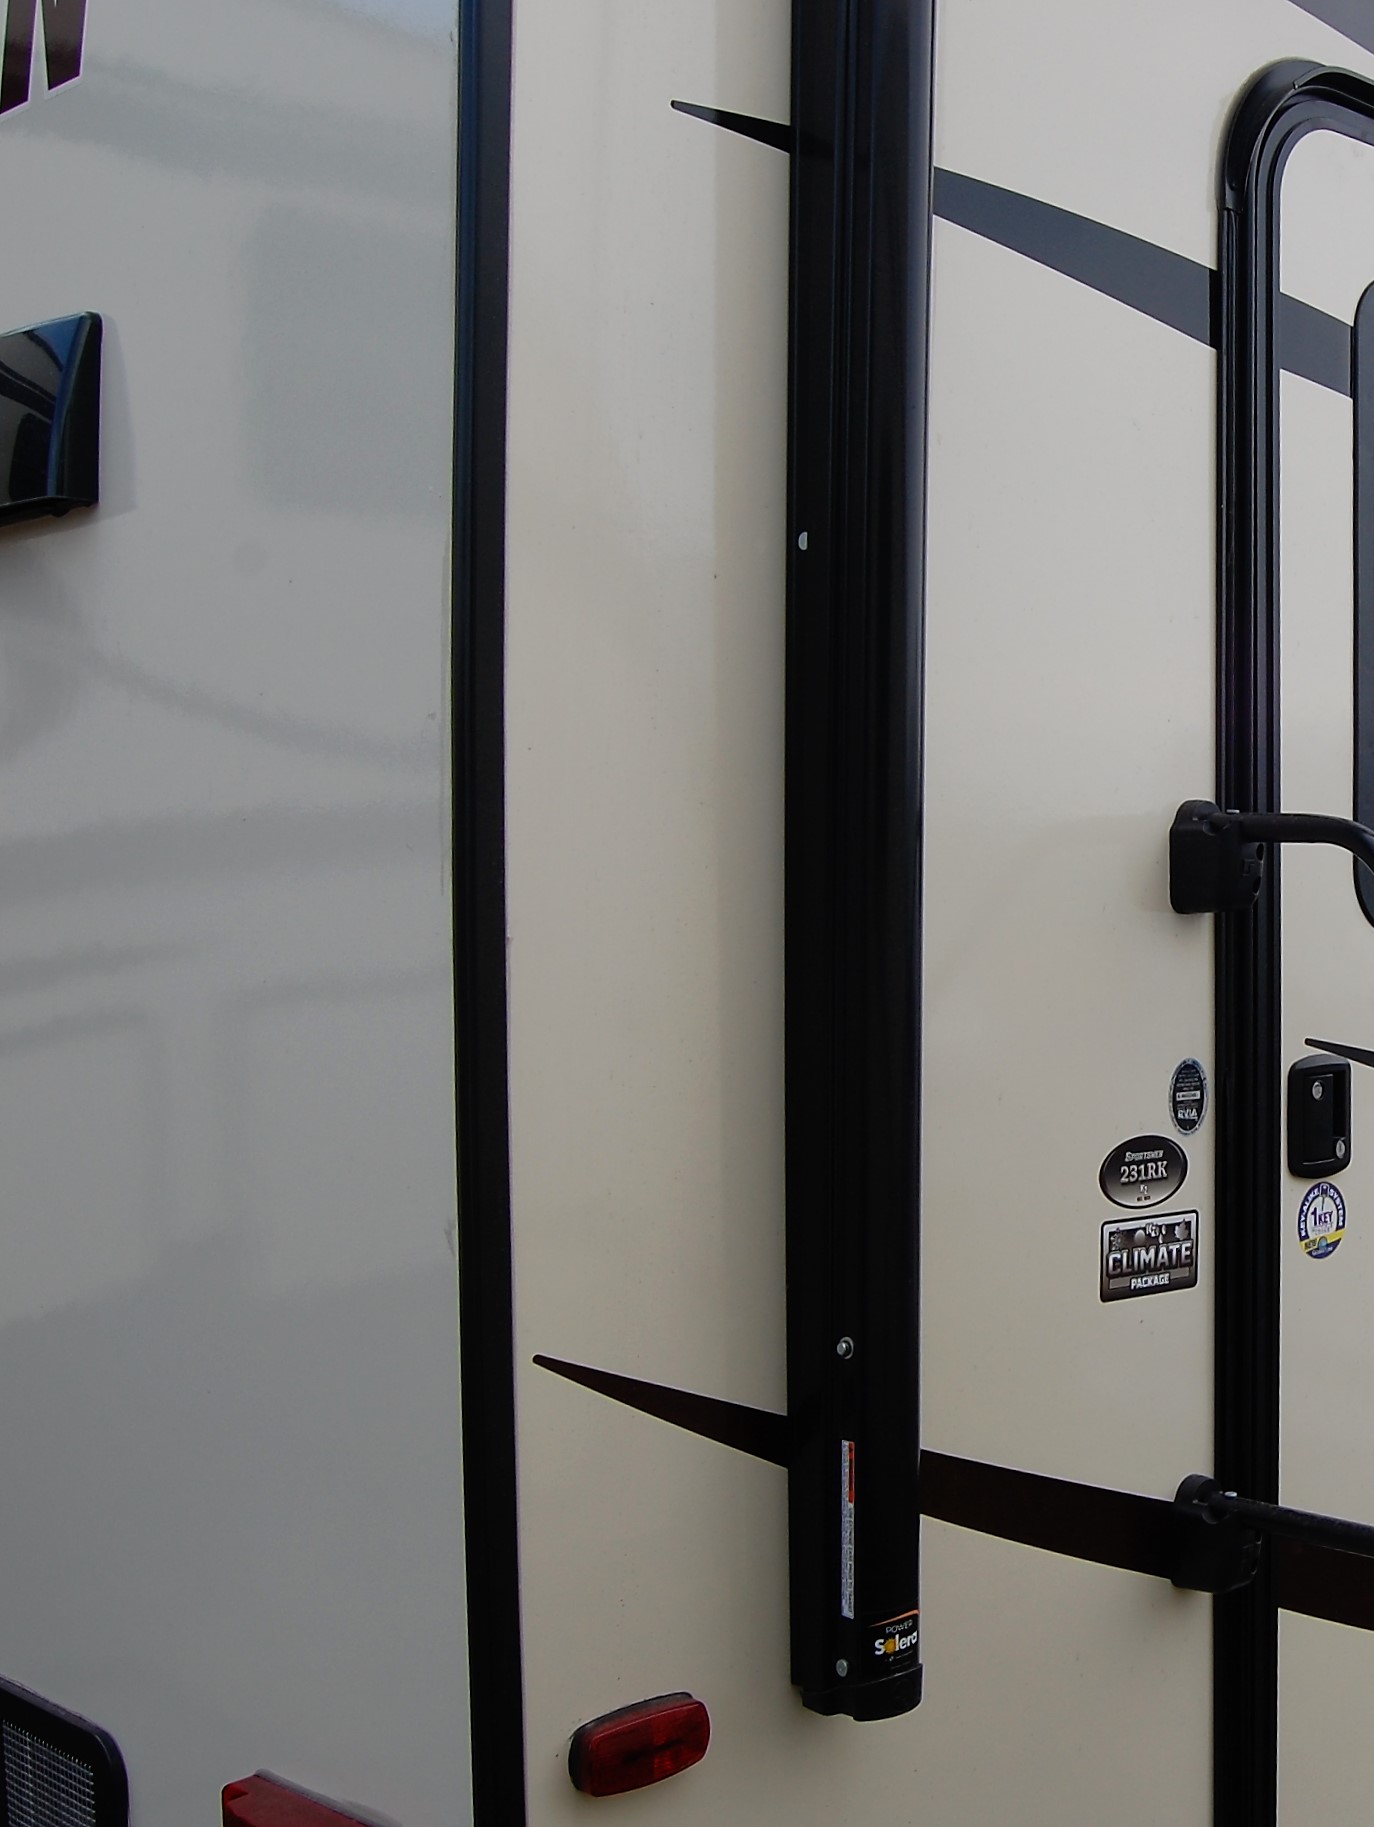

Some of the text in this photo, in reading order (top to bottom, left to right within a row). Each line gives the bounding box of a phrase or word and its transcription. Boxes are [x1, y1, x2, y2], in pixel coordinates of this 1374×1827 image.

[1120, 1161, 1167, 1183] 231RK
[1329, 1188, 1344, 1227] SYSTEM
[1107, 1241, 1193, 1276] CLIMATE
[1130, 1273, 1170, 1290] PACKAGE
